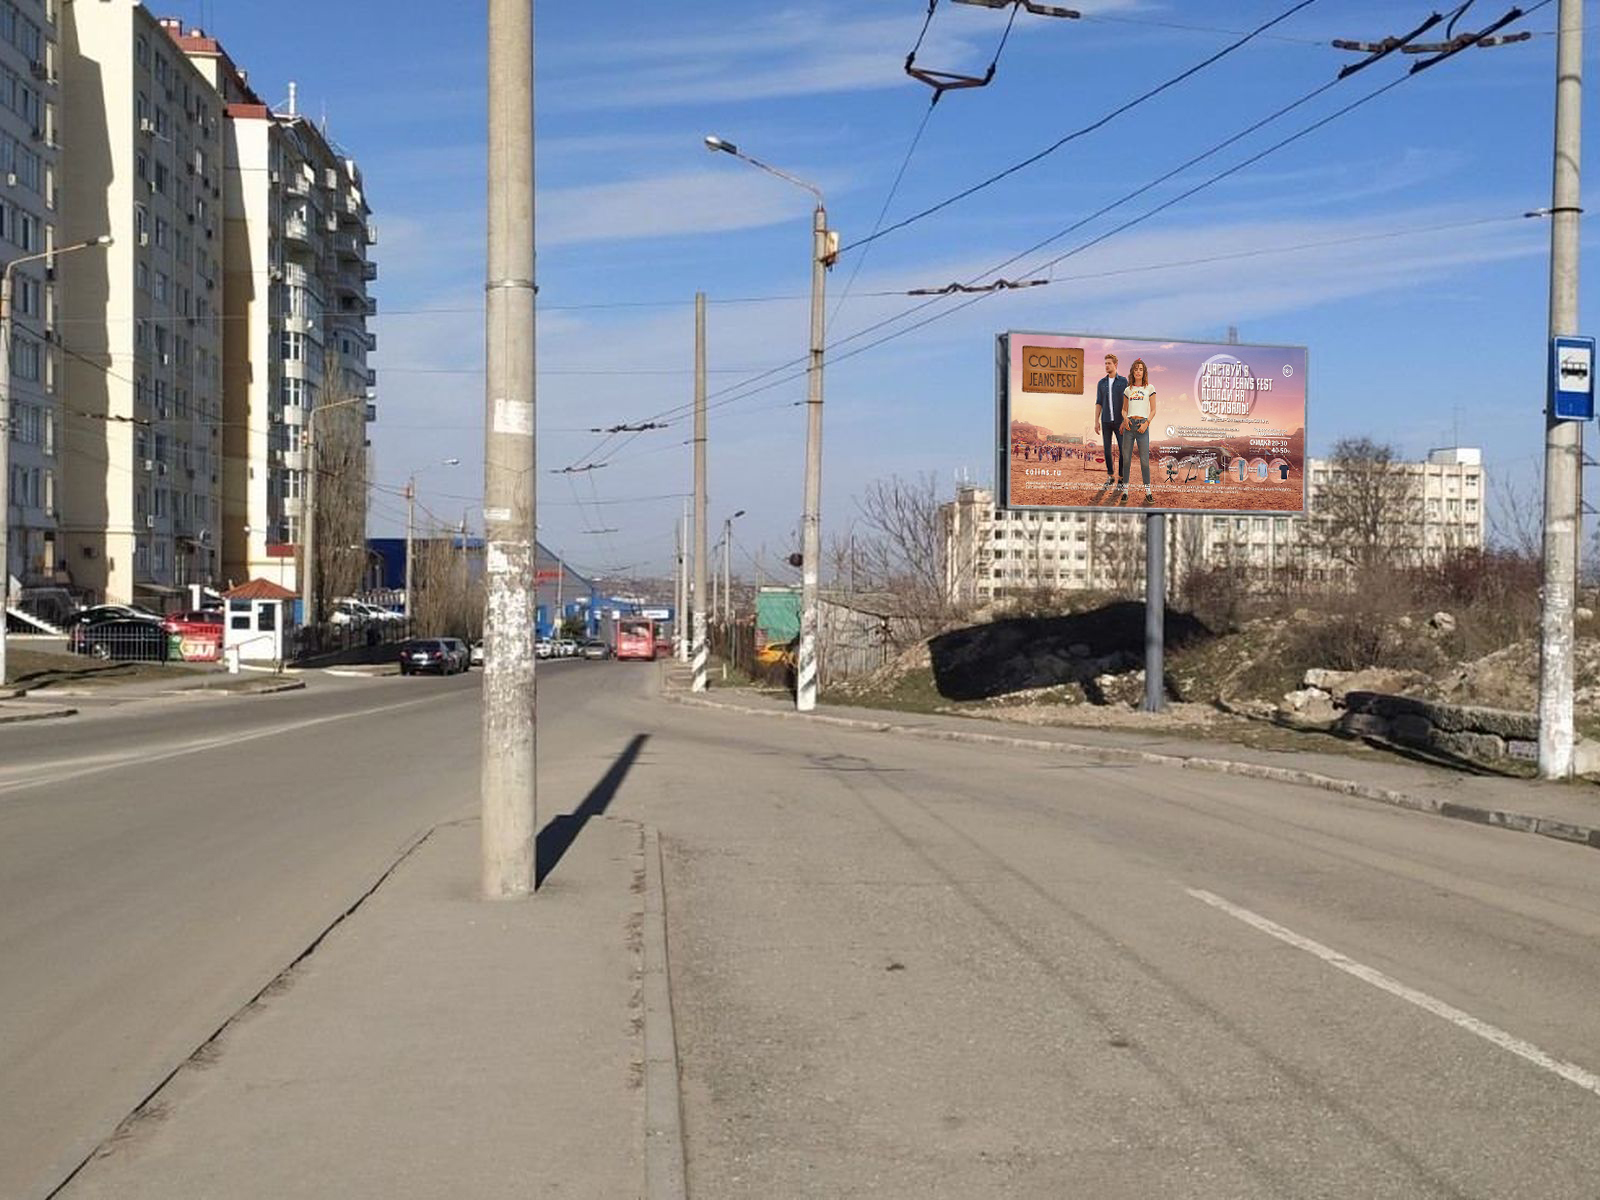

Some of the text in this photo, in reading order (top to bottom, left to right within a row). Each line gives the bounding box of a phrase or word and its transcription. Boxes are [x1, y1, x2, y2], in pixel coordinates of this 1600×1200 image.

[1028, 354, 1078, 369] COLIN'S
[1201, 361, 1250, 377] УЧАСТВУЙ В
[1029, 372, 1077, 388] JEANS FEST
[1201, 375, 1273, 391] COLIN'S JEANS FEST
[1201, 388, 1245, 402] ПОПАДИ НА
[1201, 400, 1249, 415] ФЕСТИВАЛЬ!
[1025, 467, 1062, 476] colins.ru
